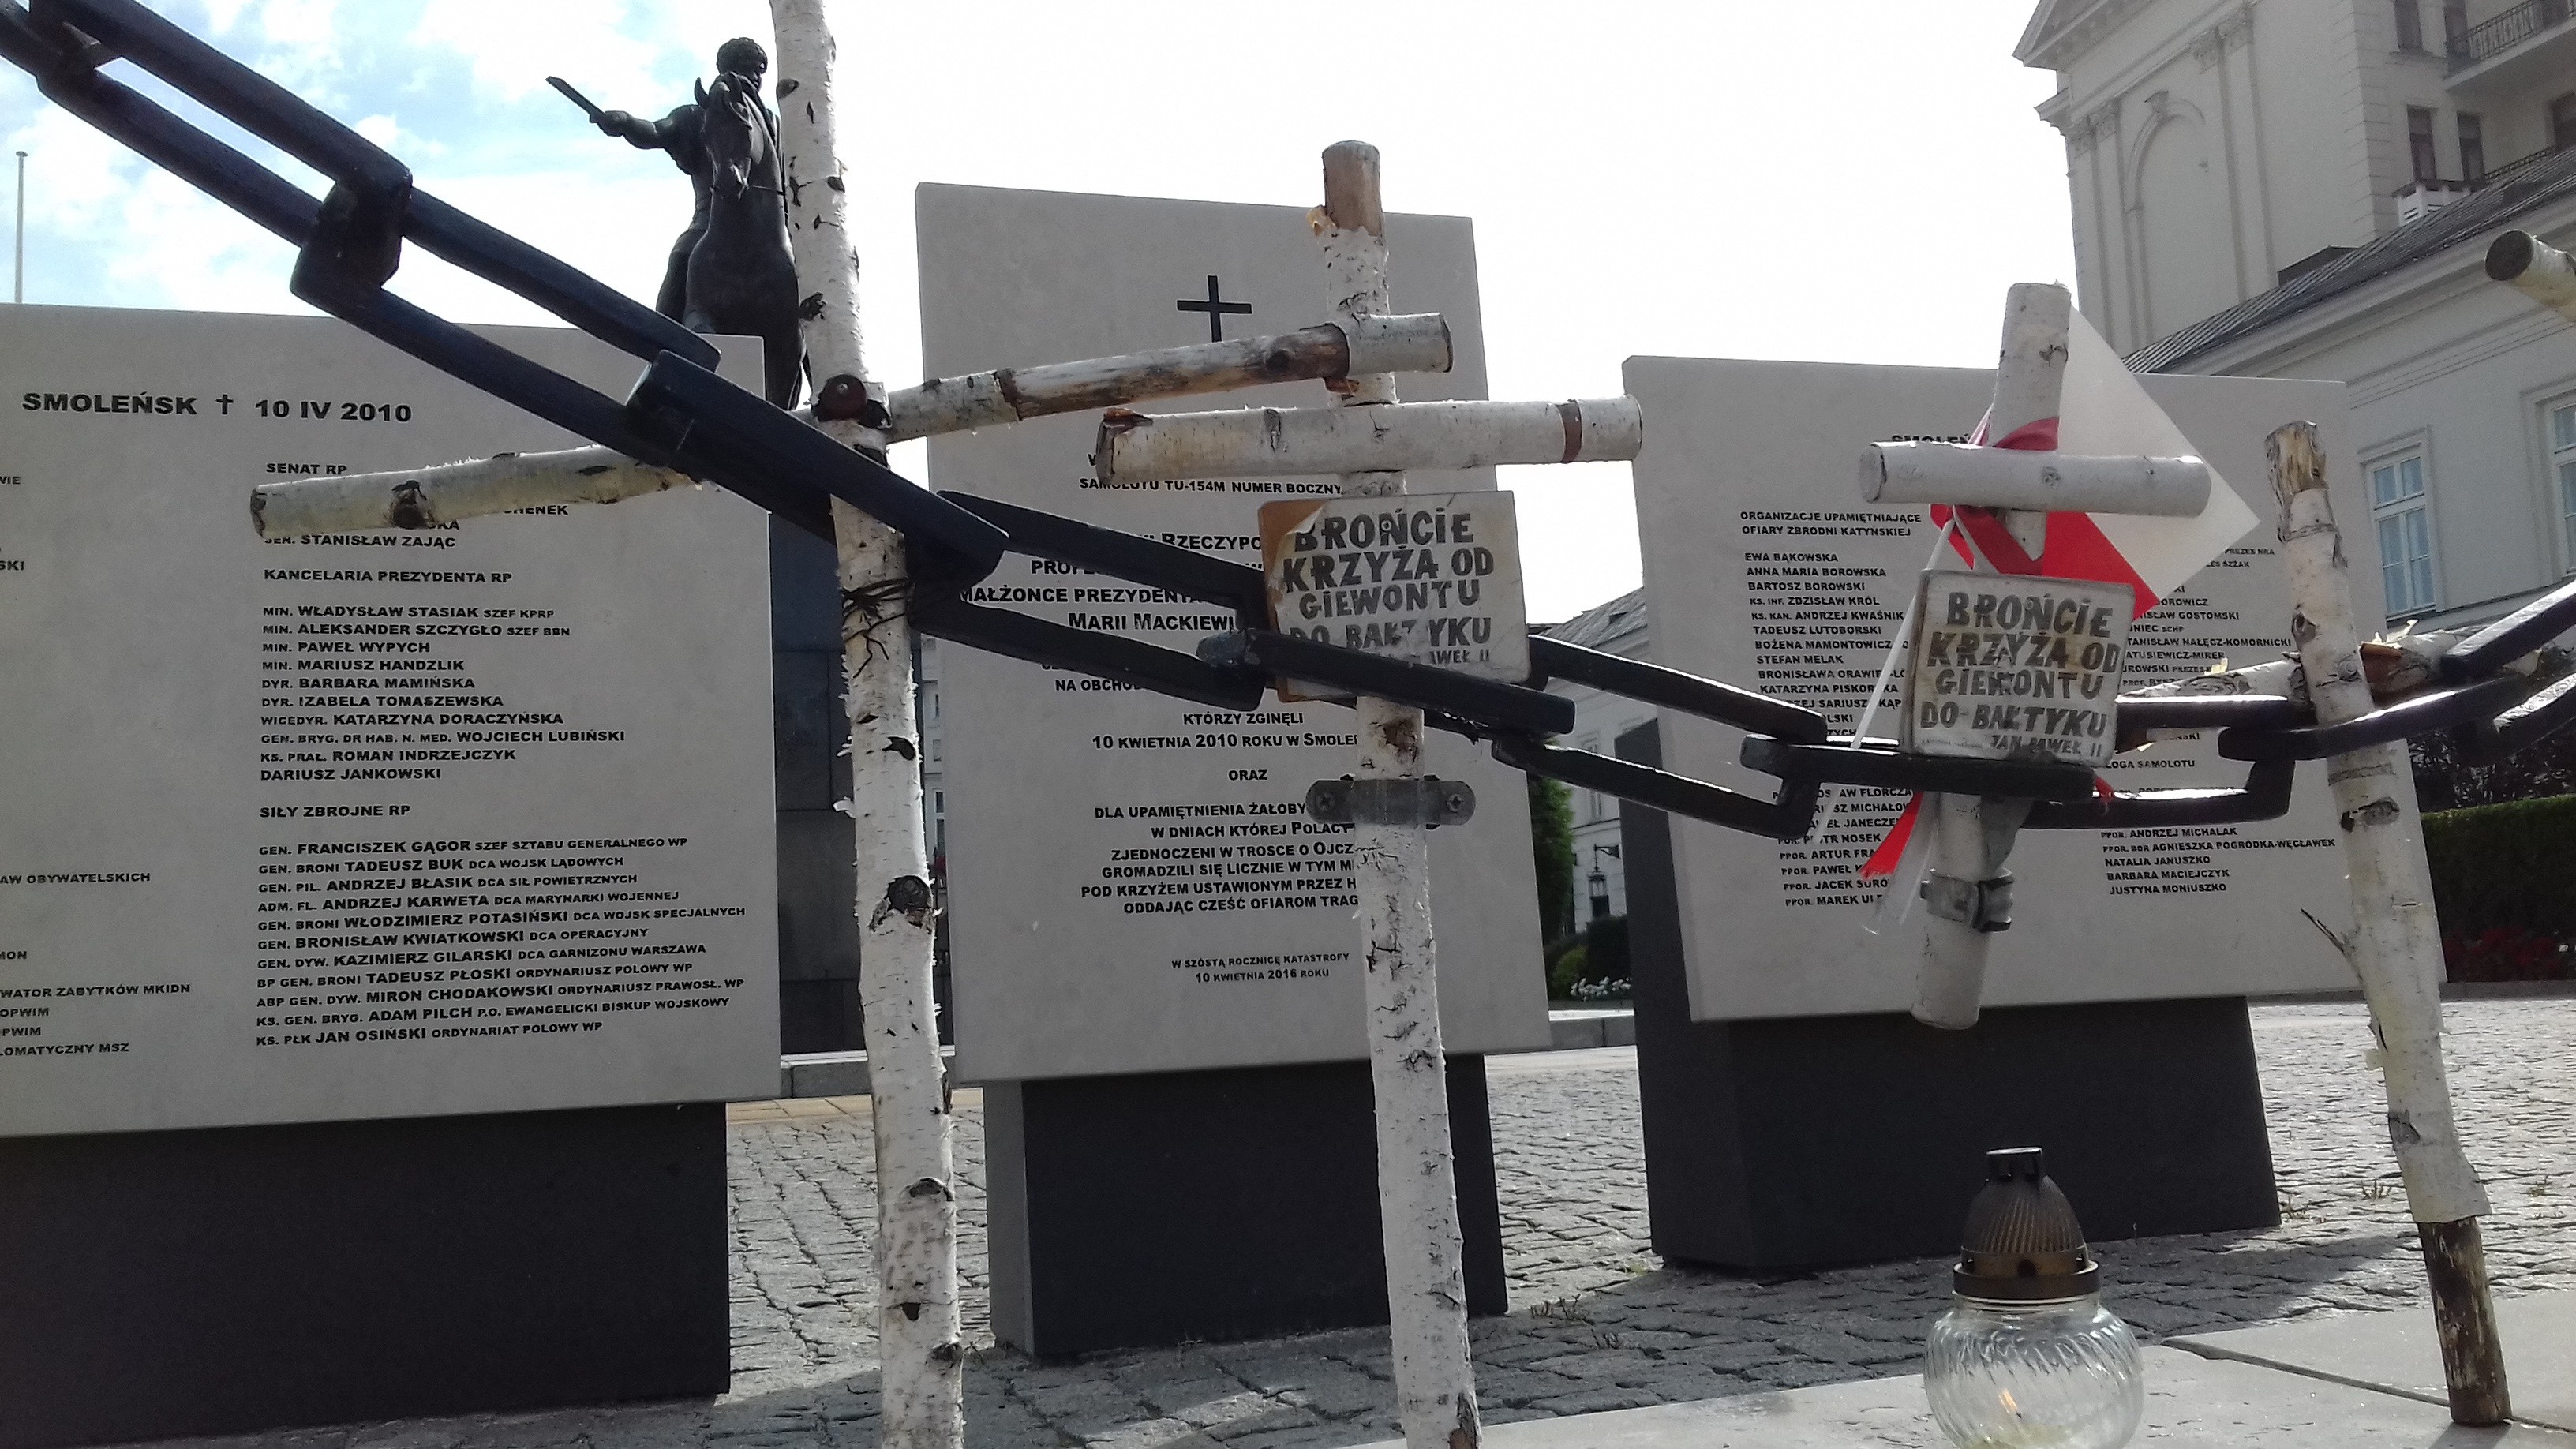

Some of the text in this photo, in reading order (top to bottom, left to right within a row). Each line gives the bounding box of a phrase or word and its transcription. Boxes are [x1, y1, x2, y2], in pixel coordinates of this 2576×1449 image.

[22, 391, 413, 423] SMOLEŃSK 10 IV 2010
[266, 463, 346, 474] SENAT RP
[1164, 480, 1341, 495] TU-154M NUMER BOCZNY
[1740, 511, 1921, 523] ORGANIZACJE UPAMIĘTNIAJĄCE
[1294, 507, 1473, 552] BROŃCIE
[301, 534, 455, 549] STANISŁAW ZAJĄC
[264, 569, 511, 582] KANCELARIA PREZYDENTA RP
[1283, 545, 1494, 593] KRZYŻA OD
[1822, 567, 1885, 576] BOROWSKA
[1299, 579, 1481, 620] GIEWONTU
[264, 607, 292, 616] MIN.
[298, 606, 402, 616] WŁADYSŁAW
[408, 607, 478, 616] STASIAK
[1947, 593, 2113, 638] BROŃCIE
[1068, 612, 1127, 631] MARII
[297, 624, 410, 634] ALEKSANDER
[415, 624, 501, 635] SZCZYGŁO
[298, 642, 354, 652] PAWEŁ
[358, 642, 429, 652] WYPYCH
[1927, 631, 2121, 673] KRZYŻA OD
[298, 660, 374, 670] MARIUSZ
[380, 660, 463, 670] HANDZLIK
[1757, 655, 1799, 664] STEFAN
[262, 676, 474, 688] DYR. BARBARA MAMIŃSKA
[262, 696, 503, 706] DYR. IZABELA TOMASZEWSKA
[333, 714, 434, 724] KATARZYNA
[440, 713, 563, 724] DORACZYŃSKA
[1183, 711, 1302, 725] KTÓRZY ZGINĘLI
[1920, 701, 2108, 738] DO BAŁTYKU
[1092, 734, 1298, 748] 10 KWIETNIA 2010 ROKU W
[260, 753, 283, 762] KS.
[333, 751, 393, 761] ROMAN
[399, 750, 515, 760] INDRZEJCZYK
[260, 768, 440, 780] DARIUSZ JANKOWSKI
[1228, 769, 1267, 780] ORAZ
[260, 805, 410, 817] SIŁY ZBROJNE RP
[1094, 800, 1308, 818] DLA UPAMIĘTNIENIA ŻAŁOBY
[1151, 823, 1286, 837] W DNIACH KTÓREJ
[2129, 826, 2237, 838] ANDRZEJ MICHALAK
[259, 837, 687, 855] GEN. FRANCISZEK GĄGOR SZEF SZTABU GENERALNEGO WP
[1111, 844, 1309, 860] ZJEDNOCZENI W TROSCE O
[2152, 842, 2213, 851] AGNIESZKA
[2153, 856, 2210, 864] JANUSZKO
[1102, 860, 1335, 878] GROMADZILI SIĘ LICZNIE W TYM
[2106, 869, 2229, 880] BARBARA MACIEJCZYK
[1081, 878, 1342, 897] POD KRZYŻEM USTAWIONYM PRZEZ
[2109, 883, 2226, 894] JUSTYNA MONIUSZKO
[1124, 896, 1316, 913] ODDAJĄC CZEŚĆ OFIAROM
[257, 928, 647, 949] GEN. BRONISŁAW KWIATKOWSKI DCA OPERACYJNY
[1283, 953, 1348, 963] KATASTROFY
[1196, 968, 1328, 982] 10 KWIETNIA 2016 ROKU
[256, 1022, 601, 1045] KS. PŁK JAN OSIŃSKI ORDYNARIAT POLOWY WP
